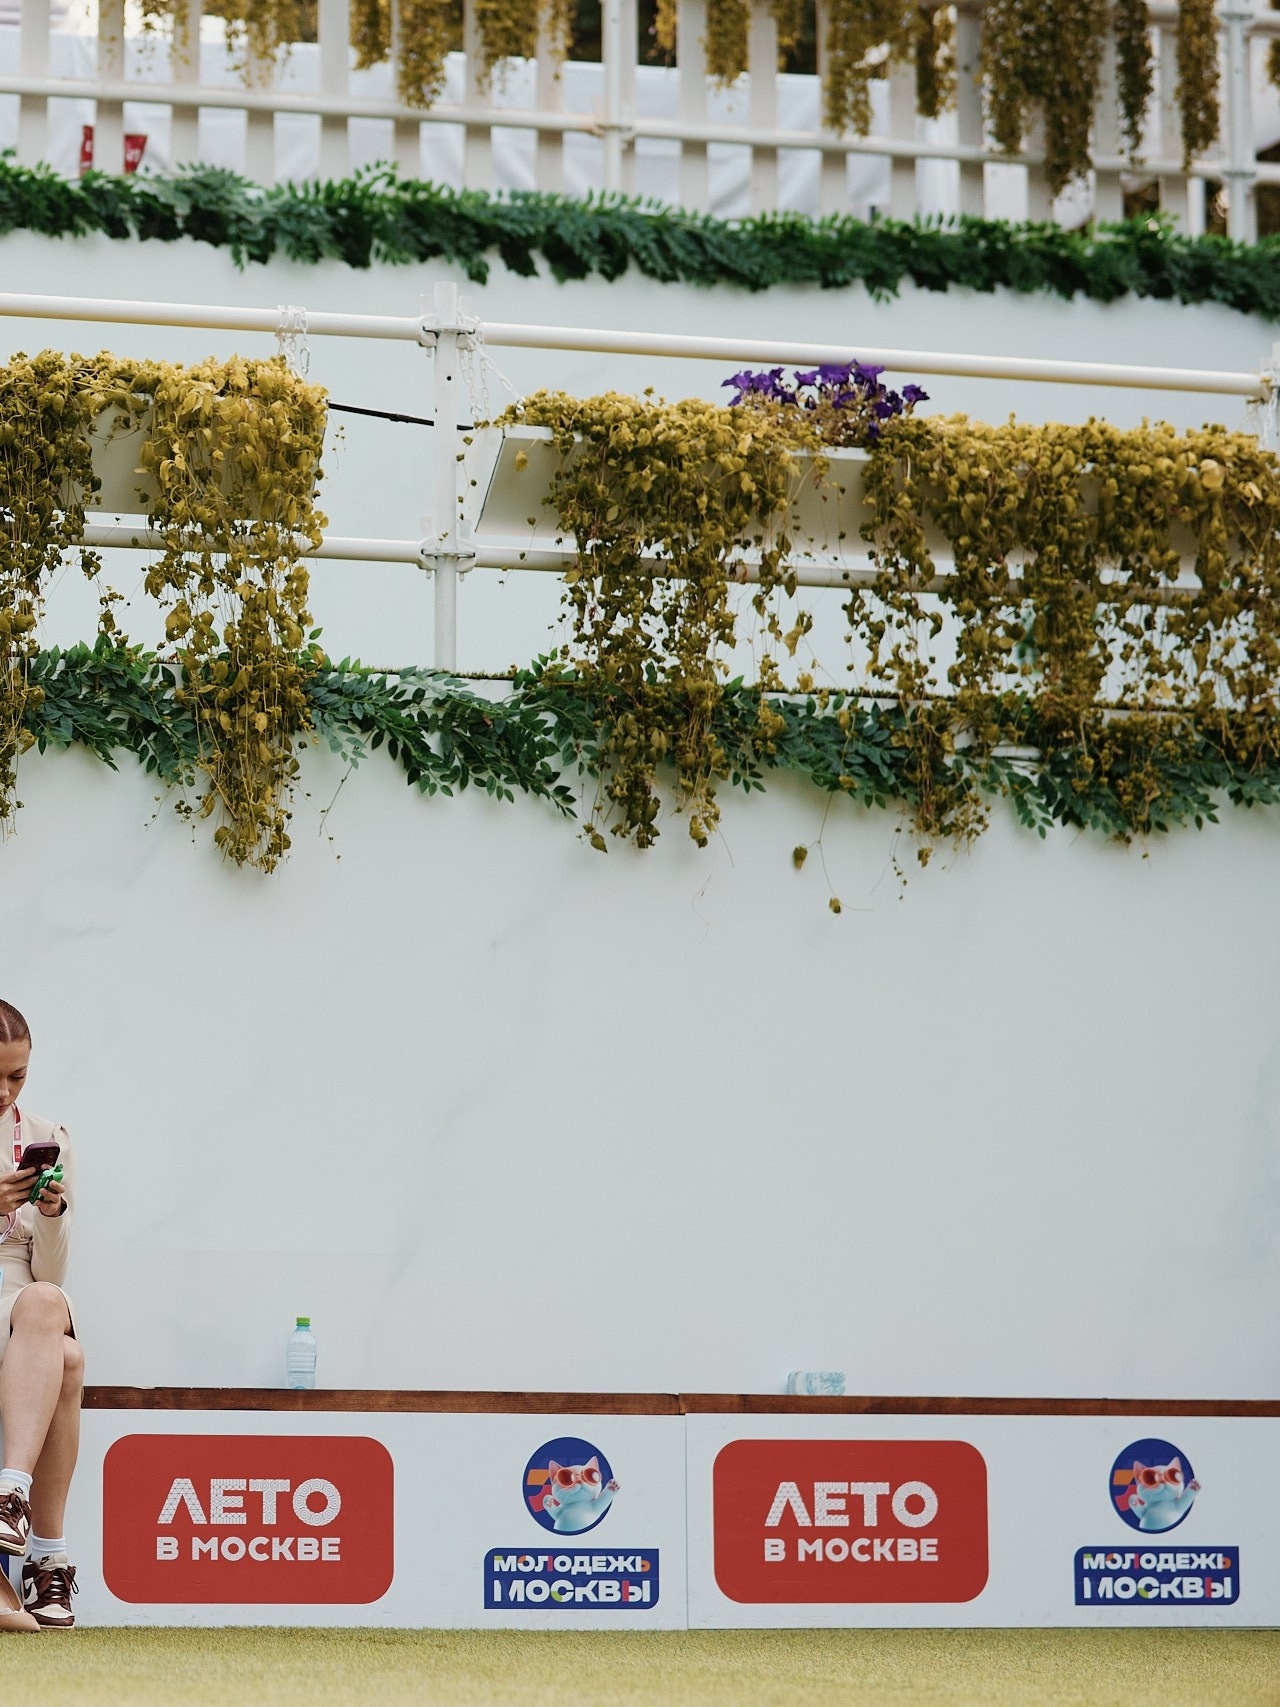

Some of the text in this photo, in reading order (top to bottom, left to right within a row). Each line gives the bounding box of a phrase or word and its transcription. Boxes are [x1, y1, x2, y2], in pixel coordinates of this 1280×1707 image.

[156, 1477, 342, 1527] ЛЕТО
[764, 1480, 939, 1529] ЛЕТО
[156, 1536, 341, 1562] В МОСКВЕ
[764, 1537, 939, 1563] В МОСКВЕ
[493, 1554, 651, 1576] МОЛОДЕЖЬ
[1083, 1552, 1232, 1572] МОЛОДЕЖЬ
[493, 1579, 651, 1603] МОСКВЫ
[1083, 1576, 1232, 1600] МОСКВЫ
